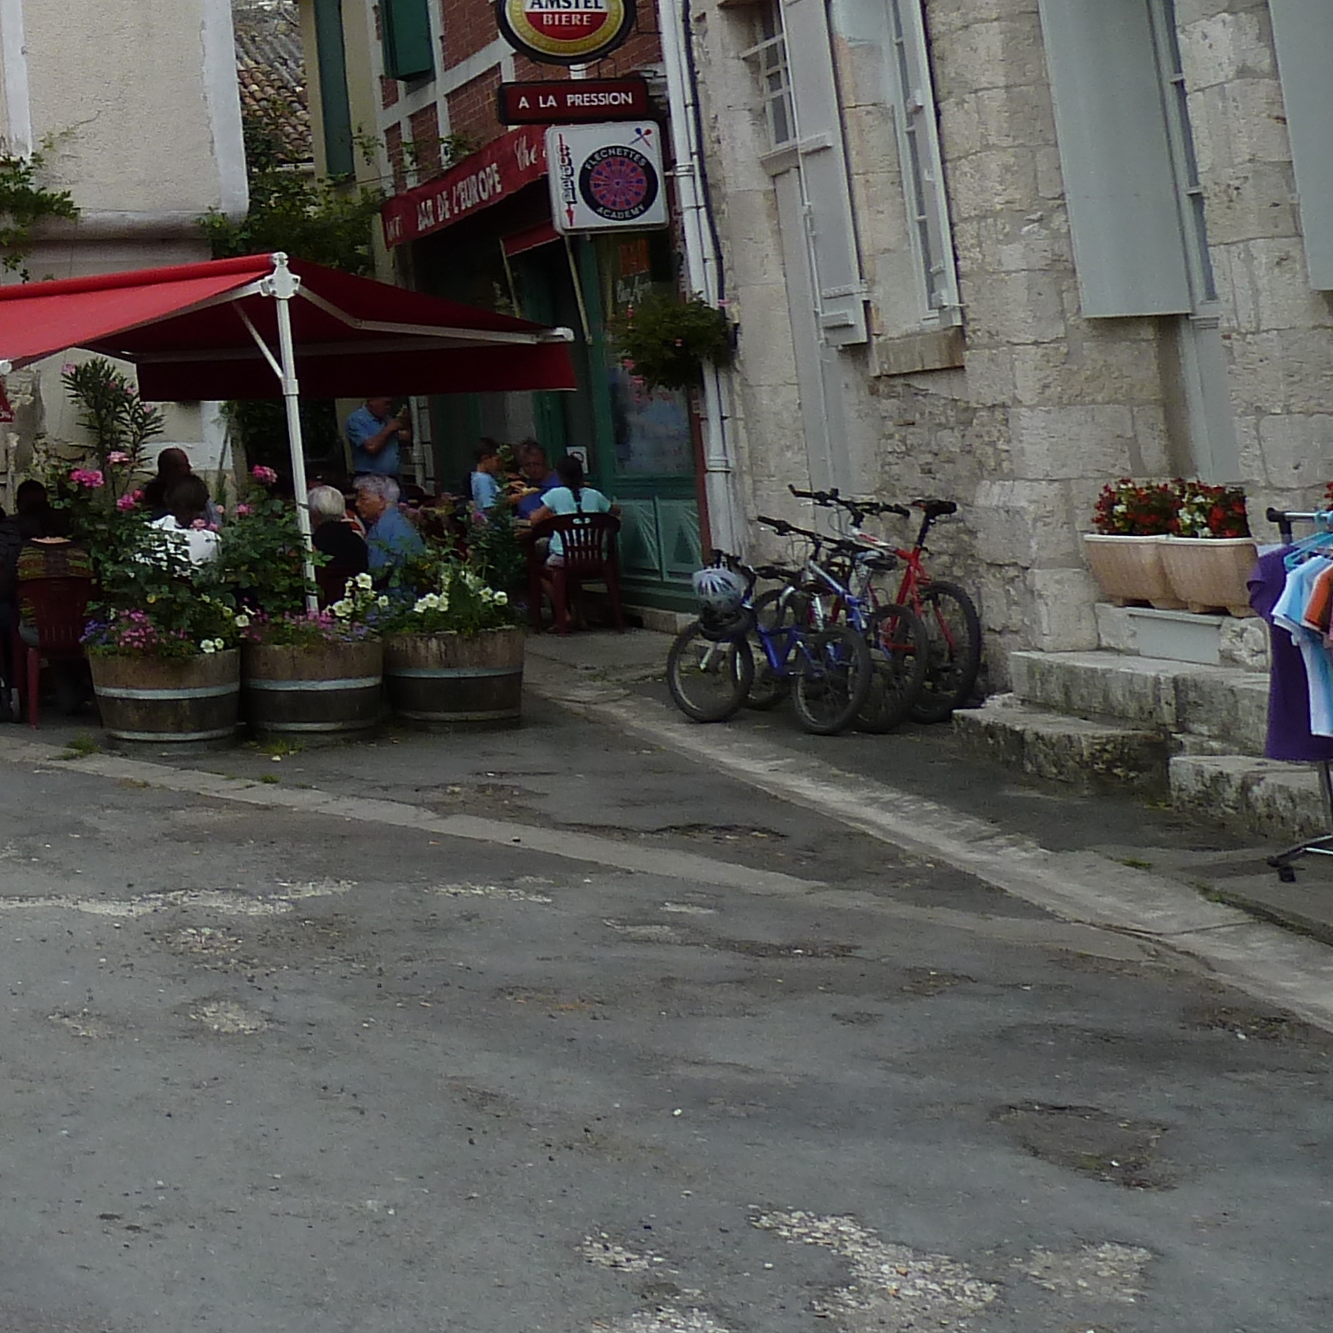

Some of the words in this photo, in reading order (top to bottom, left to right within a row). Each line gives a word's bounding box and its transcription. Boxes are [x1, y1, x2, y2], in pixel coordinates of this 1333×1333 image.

[543, 13, 592, 26] BIERE
[518, 96, 530, 109] A
[539, 94, 558, 108] LA
[566, 91, 634, 107] PRESSION
[452, 162, 503, 214] L'EUROPE
[596, 203, 646, 220] ACADEMY
